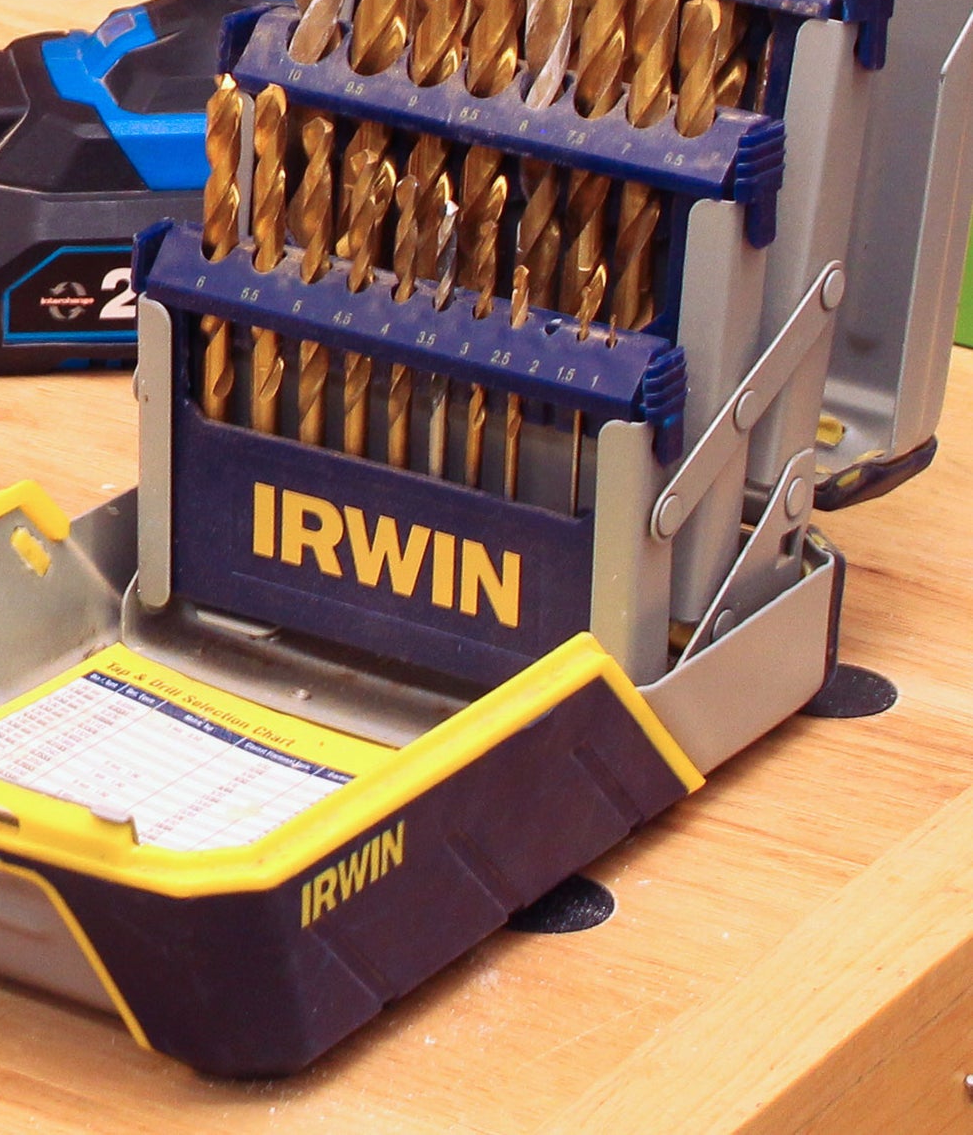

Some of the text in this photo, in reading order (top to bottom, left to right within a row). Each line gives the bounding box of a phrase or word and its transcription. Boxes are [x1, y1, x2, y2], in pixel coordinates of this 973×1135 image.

[287, 68, 302, 82] 10
[621, 141, 633, 155] 7
[663, 151, 685, 167] 6.5
[99, 267, 137, 319] 2
[195, 275, 207, 289] 6
[240, 287, 261, 303] 5.5
[292, 299, 303, 313] 5
[332, 310, 354, 326] 4.5
[380, 322, 391, 337] 4
[416, 330, 438, 347] 3.5
[459, 341, 470, 356] 3
[490, 349, 512, 366] 2.5
[528, 358, 540, 374] 2
[556, 365, 576, 383] 1.5
[253, 481, 521, 628] IRWIN
[107, 661, 131, 676] Tap
[149, 678, 183, 697] Drill
[182, 695, 251, 731] Selection
[253, 725, 297, 748] Chart
[301, 819, 405, 929] IRWIN
